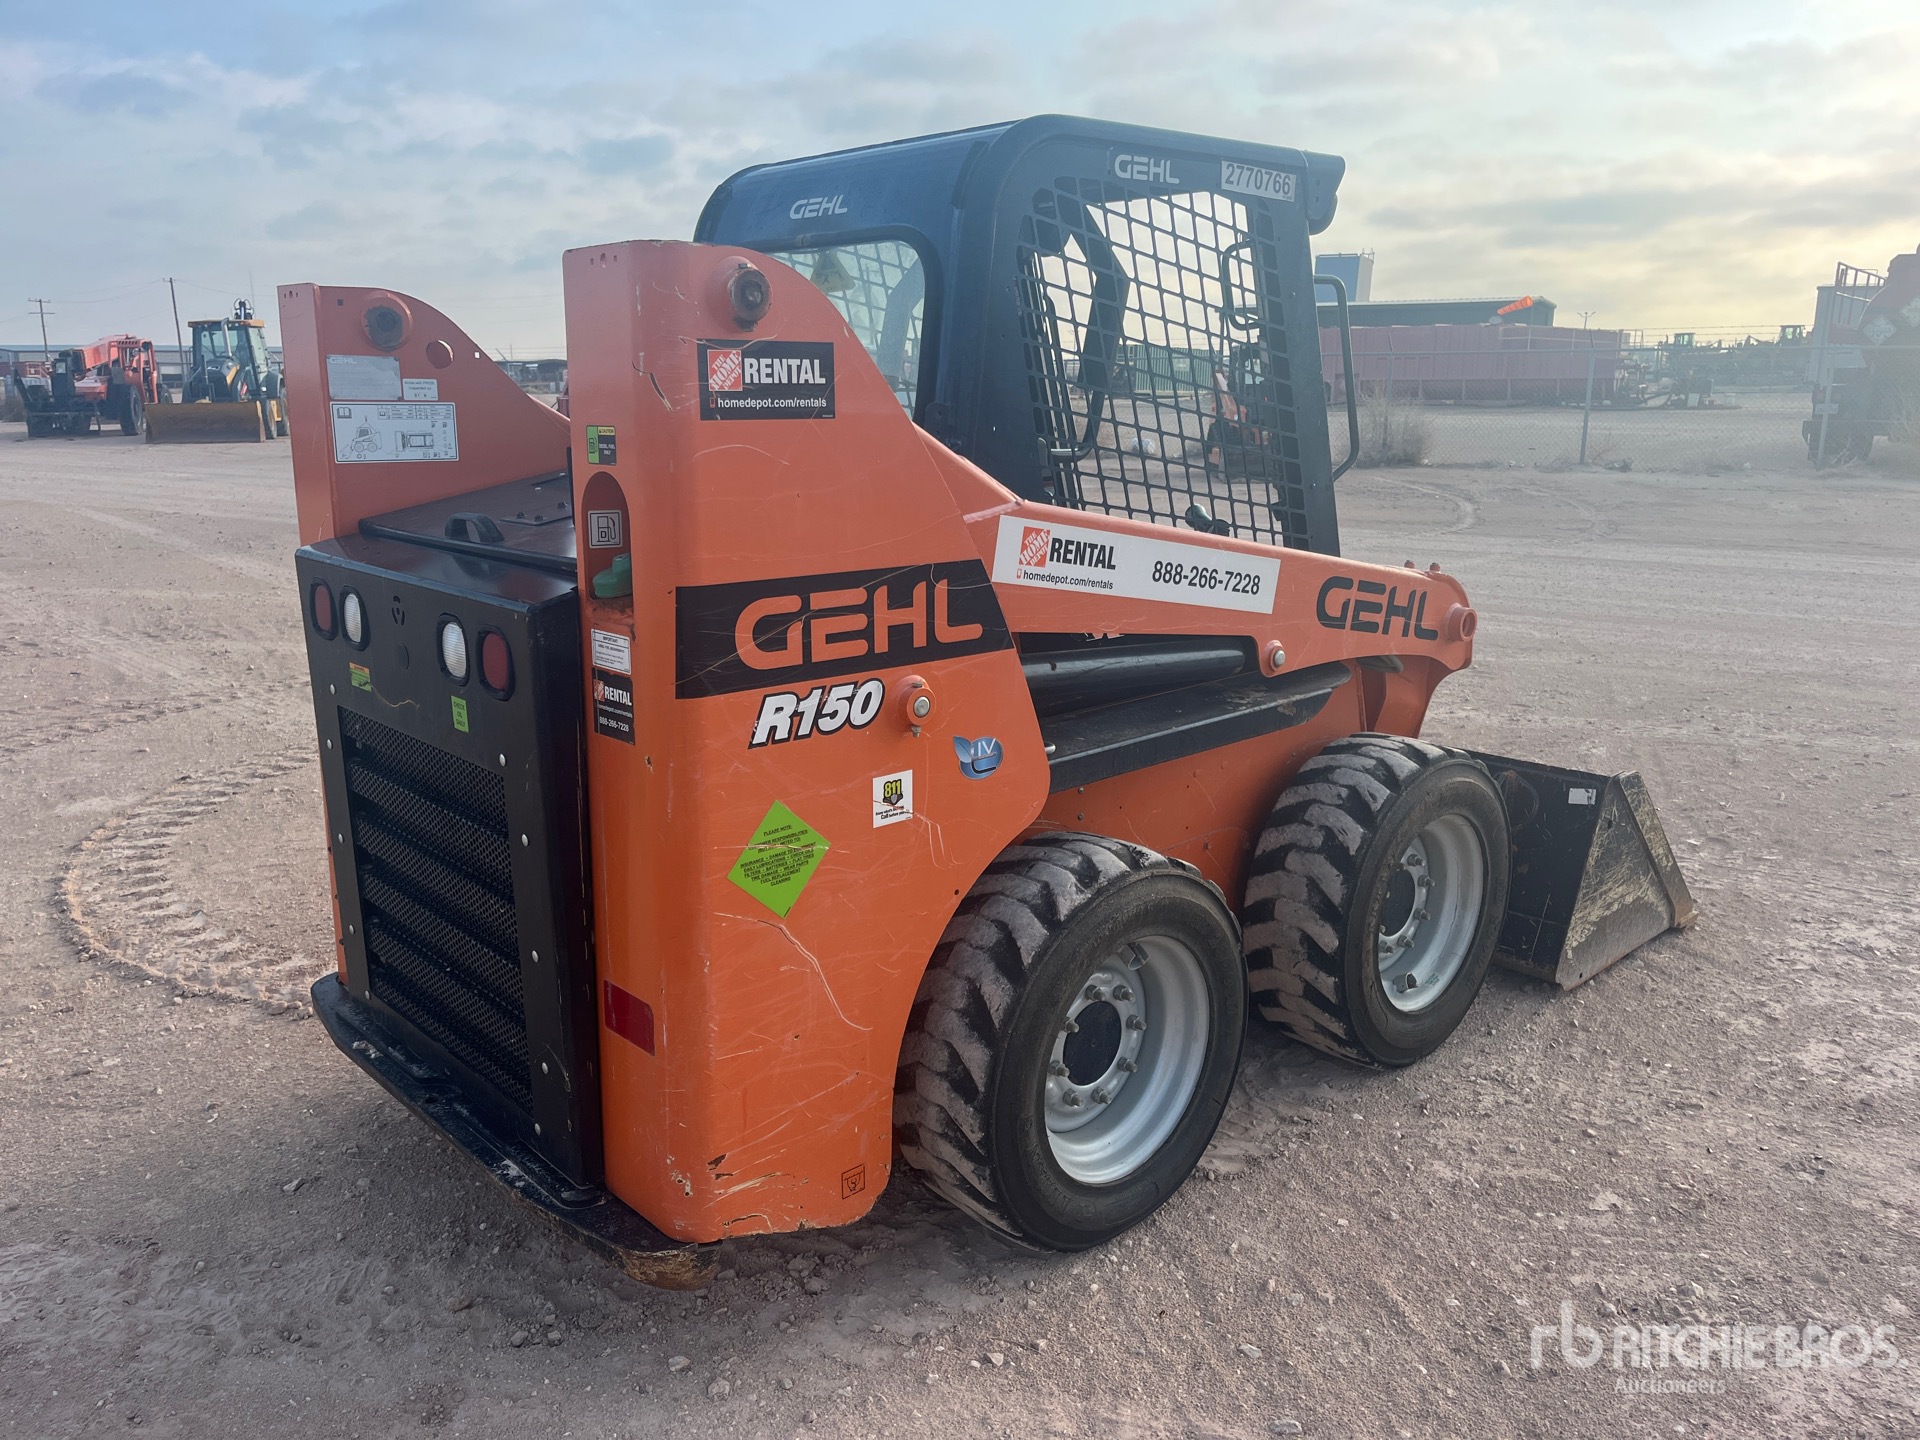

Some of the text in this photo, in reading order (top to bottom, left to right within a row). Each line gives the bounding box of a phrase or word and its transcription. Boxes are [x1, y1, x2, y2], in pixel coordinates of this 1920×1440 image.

[1115, 154, 1180, 184] GEHL
[1225, 163, 1292, 196] 2770766
[789, 195, 848, 220] GEHL
[709, 350, 742, 391] HOME
[712, 354, 727, 371] THE
[744, 358, 826, 384] RENTAL
[722, 365, 742, 391] DEPOT
[718, 397, 827, 410] homedepot.com/rentals
[1019, 529, 1050, 566] HOME
[1024, 530, 1038, 546] THE
[1049, 537, 1116, 570] RENTAL
[1023, 570, 1114, 590] homedepot.com/rentals
[1152, 560, 1260, 595] 888-266-7228
[1316, 575, 1439, 641] GEHL
[735, 578, 983, 670] GEHL
[604, 686, 632, 706] RENTAL
[750, 679, 884, 748] R150
[884, 779, 902, 798] 811
[763, 828, 780, 836] PLEASE
[740, 857, 764, 869] INSURANCE
